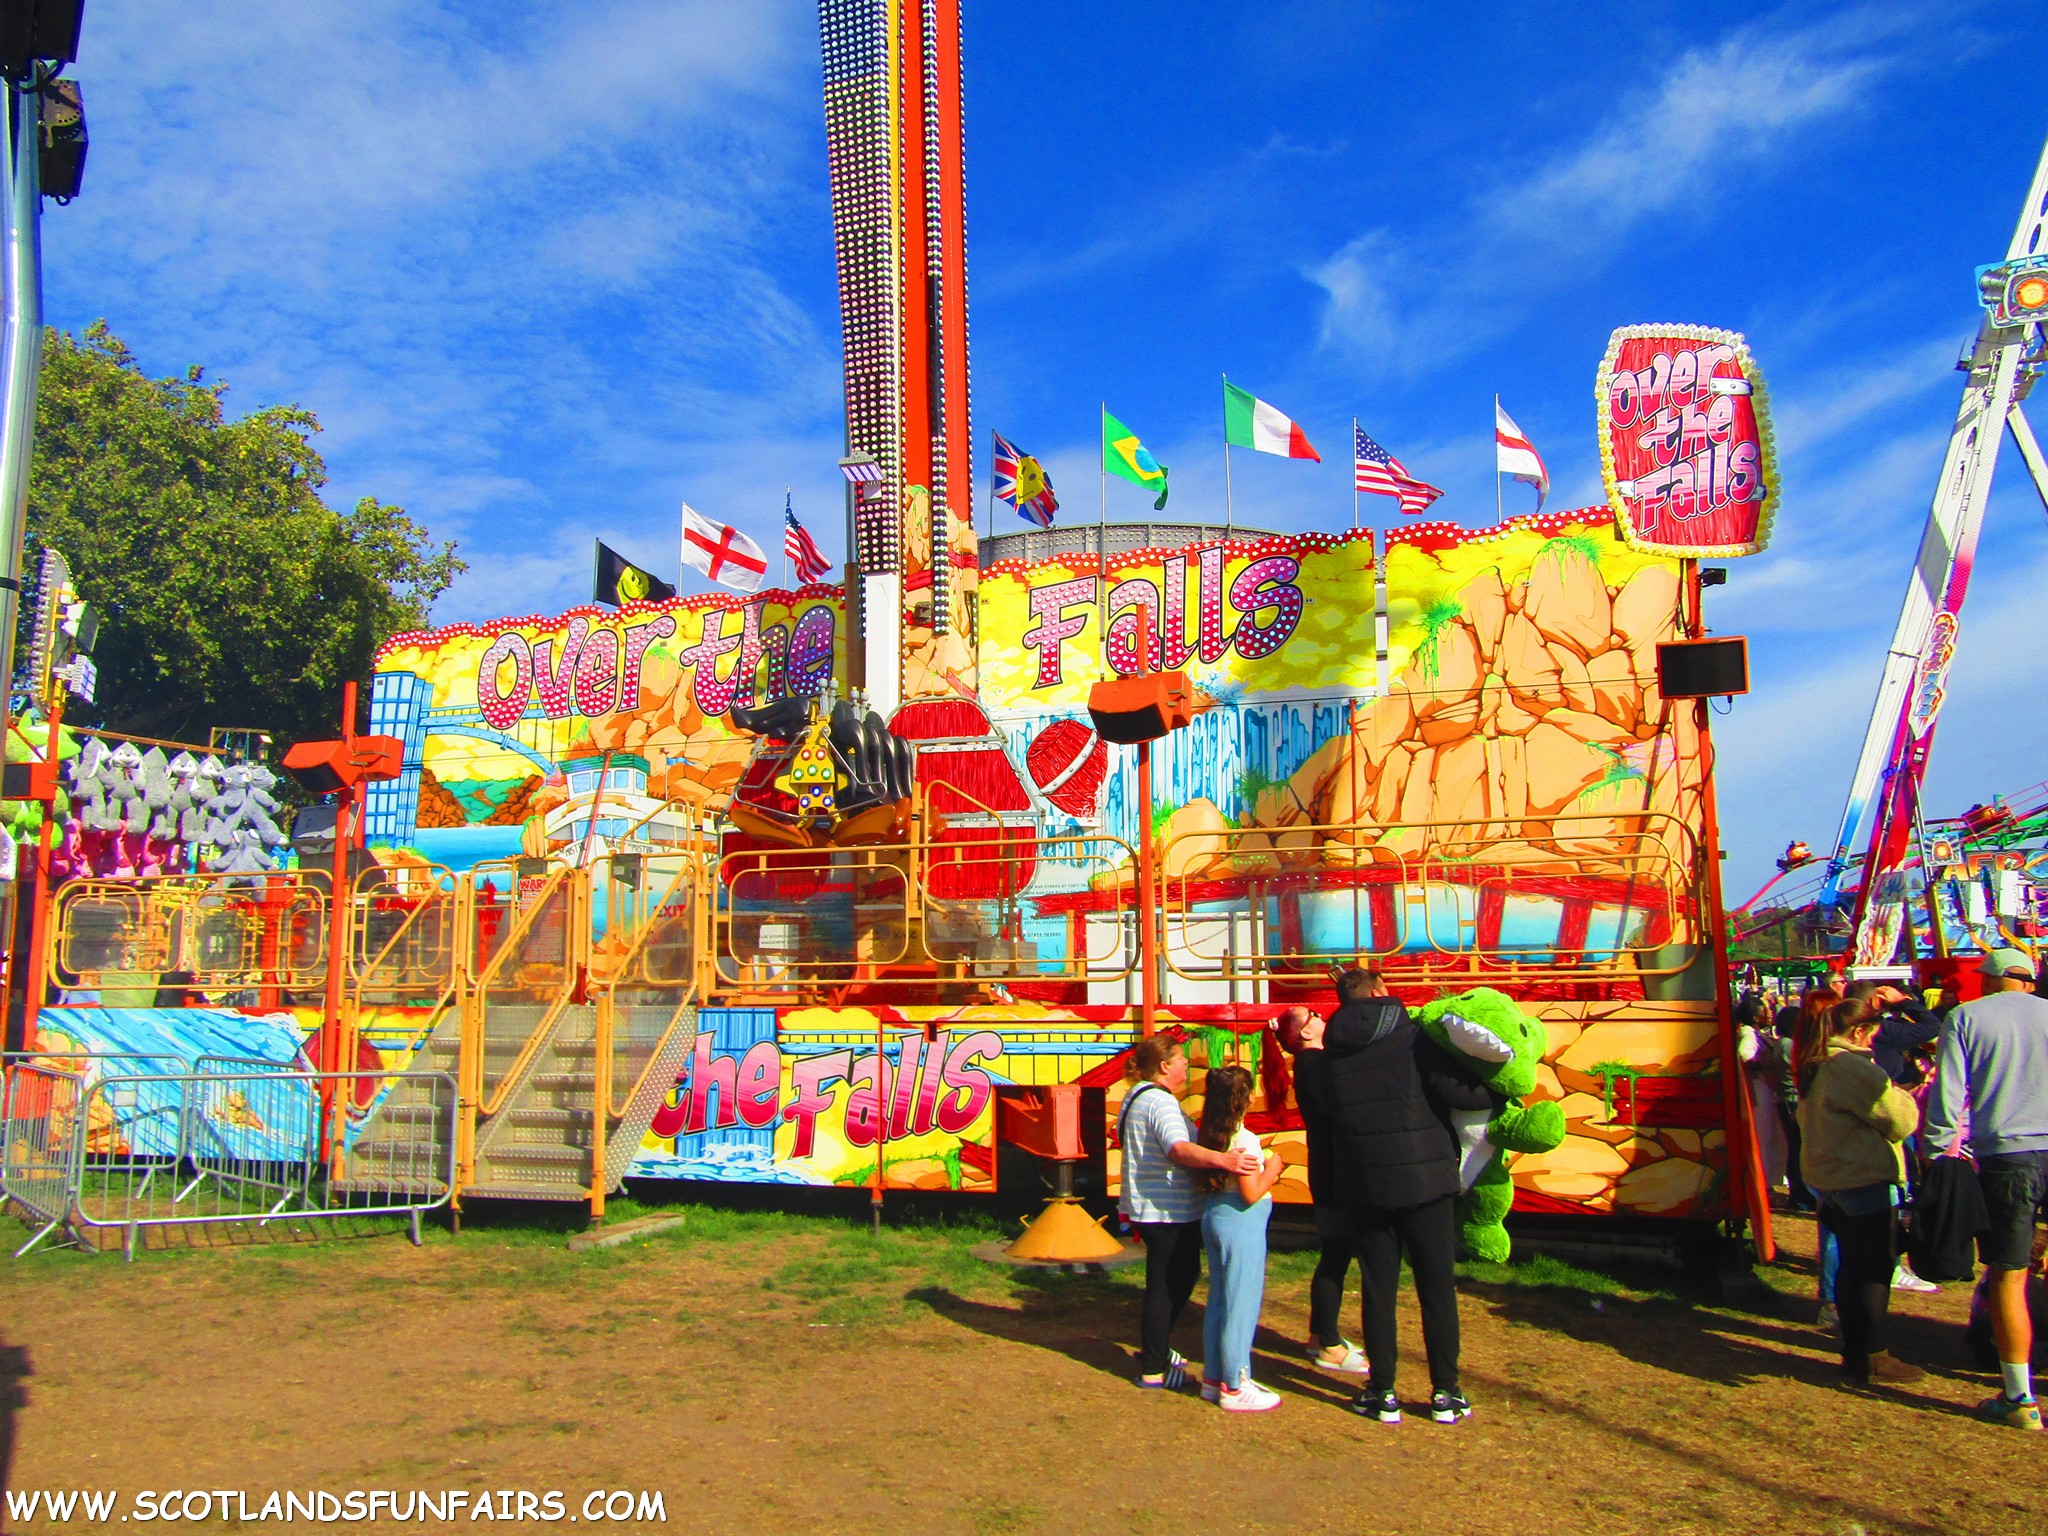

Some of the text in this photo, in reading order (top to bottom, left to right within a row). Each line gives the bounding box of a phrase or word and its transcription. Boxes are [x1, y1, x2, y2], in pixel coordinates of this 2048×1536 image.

[1637, 394, 1736, 468] the
[1632, 440, 1760, 536] Falls
[680, 598, 837, 717] the
[1021, 544, 1306, 691] Falls
[818, 882, 855, 893] NOTICE
[783, 1029, 1004, 1160] Falls
